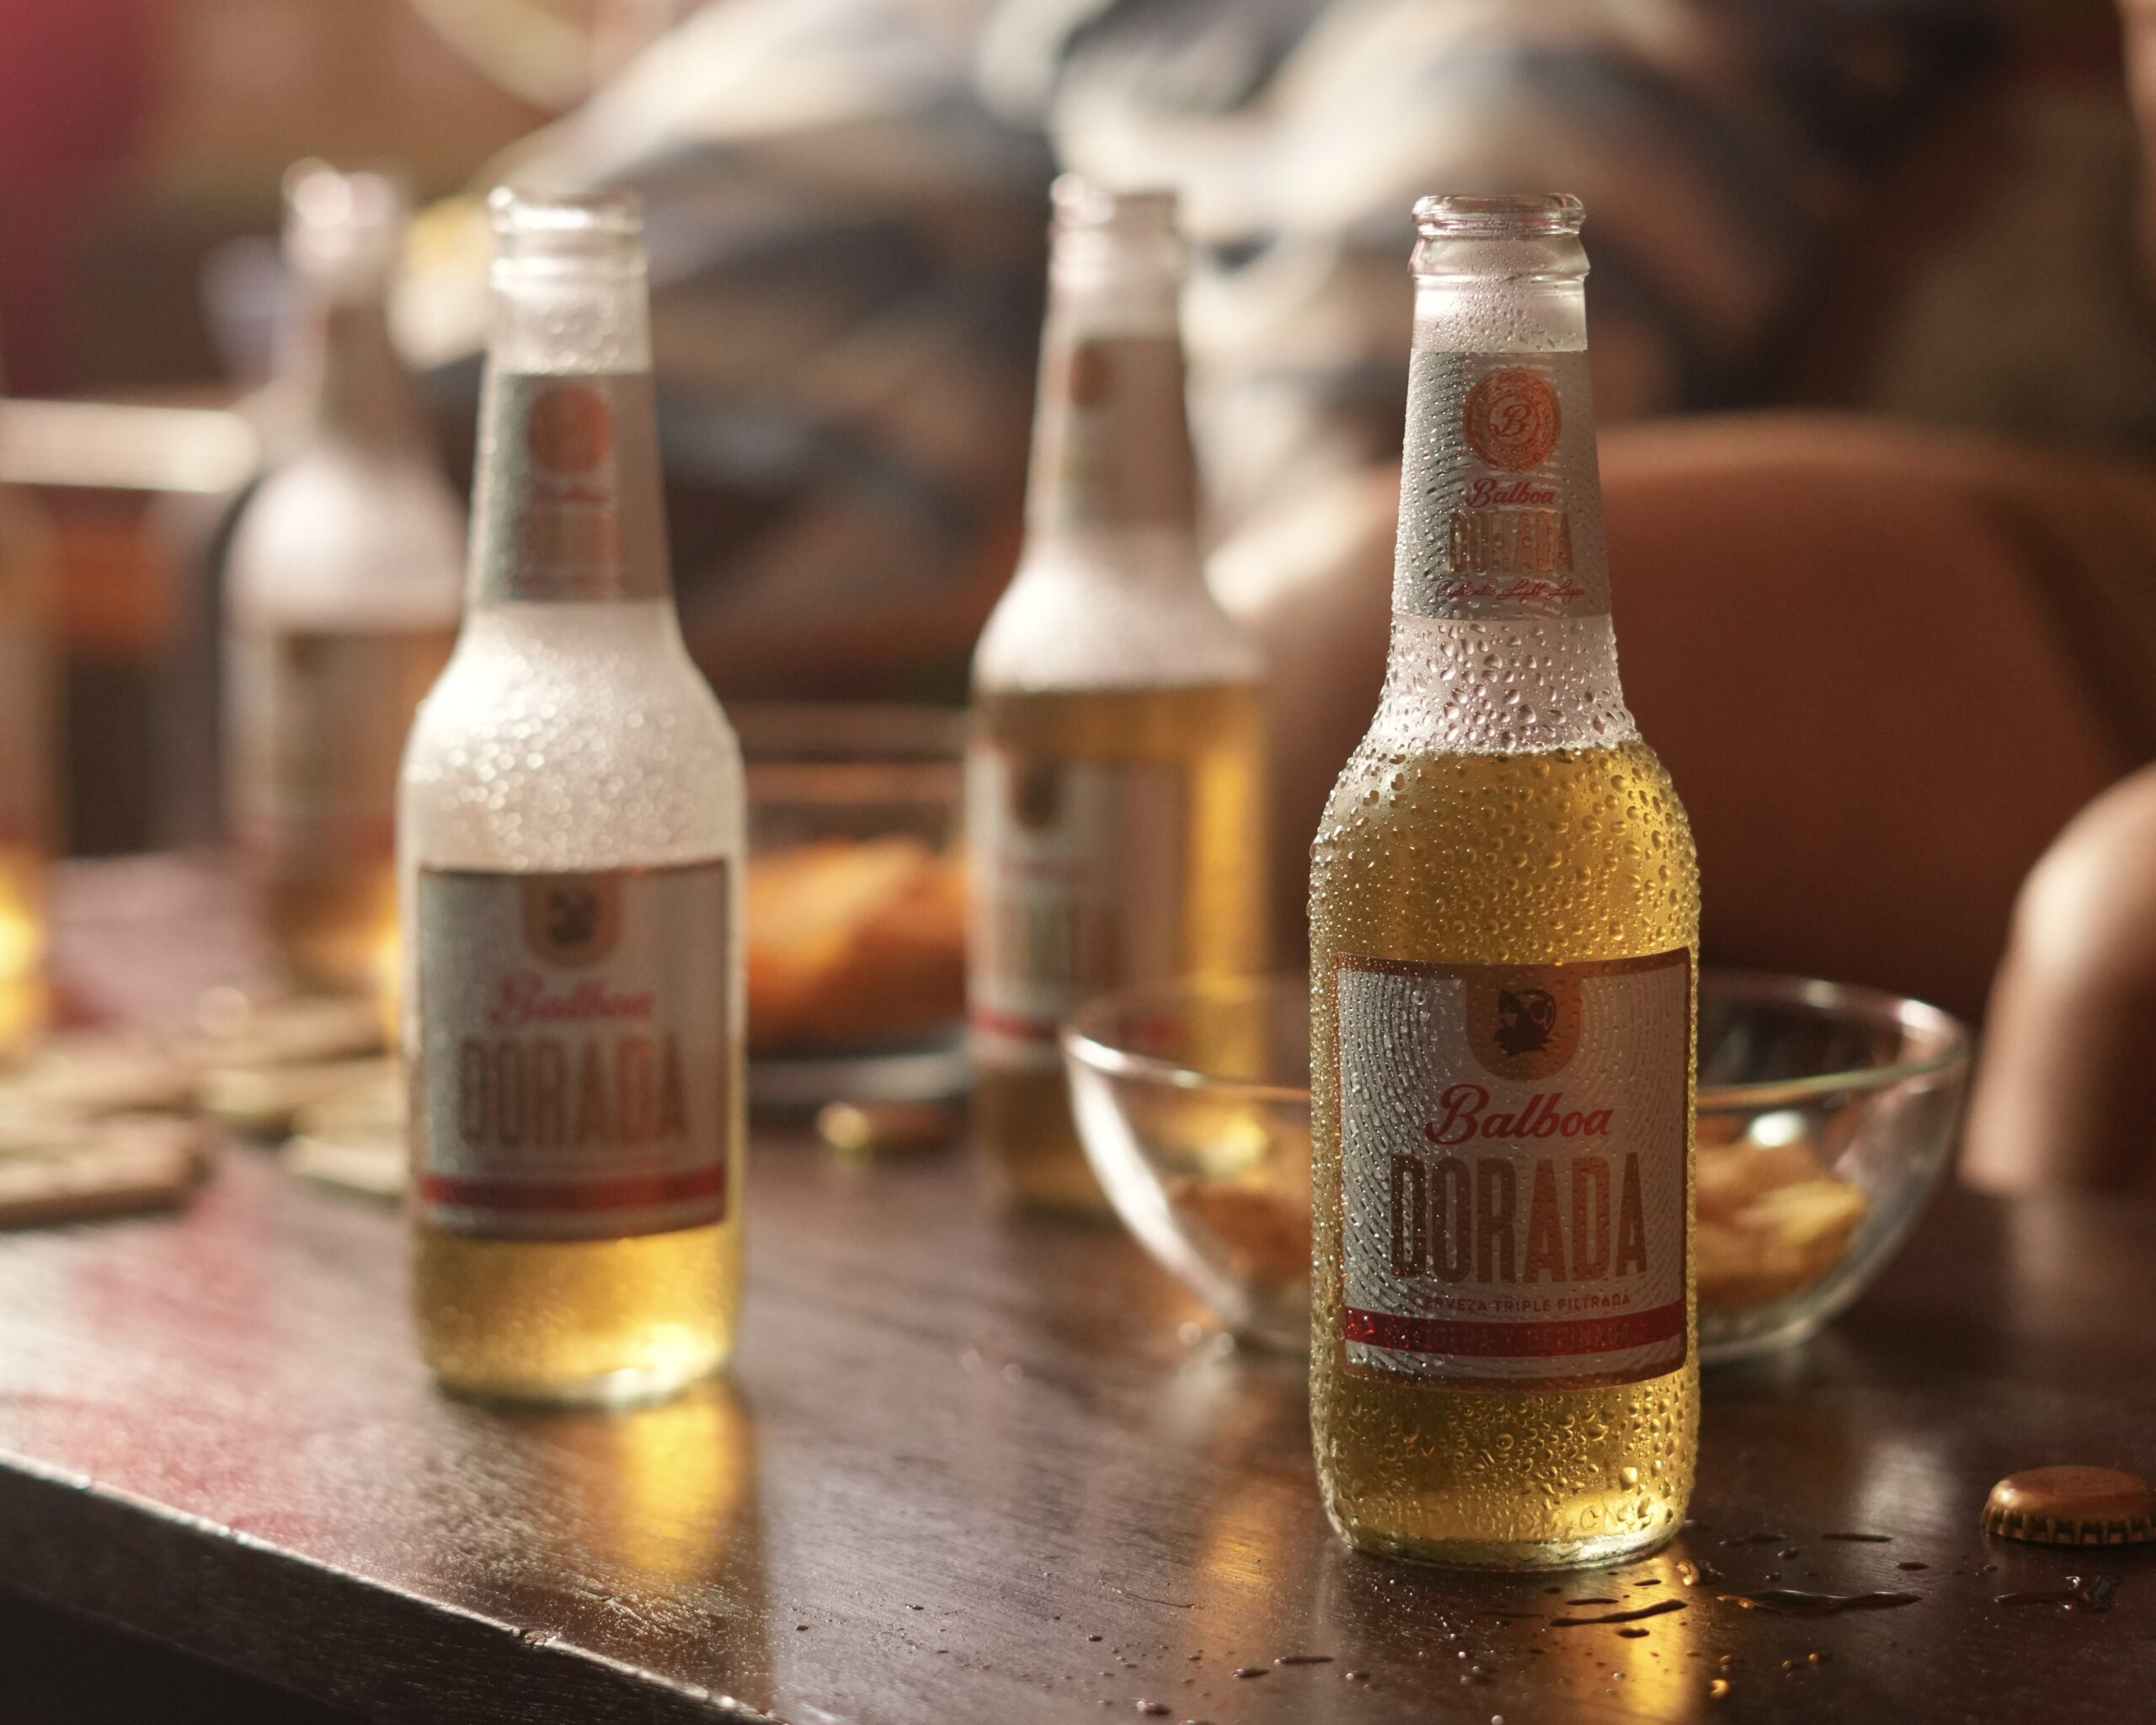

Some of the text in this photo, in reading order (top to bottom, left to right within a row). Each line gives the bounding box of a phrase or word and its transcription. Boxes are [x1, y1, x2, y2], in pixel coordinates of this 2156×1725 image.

[1489, 403, 1532, 437] B
[1465, 478, 1556, 507] Balboa
[460, 1033, 687, 1149] DORADA
[1424, 1083, 1614, 1146] Balboa
[1390, 1152, 1647, 1283] DORADA
[1415, 1293, 1630, 1313] CERVEZA TRIPLE FILTRADA
